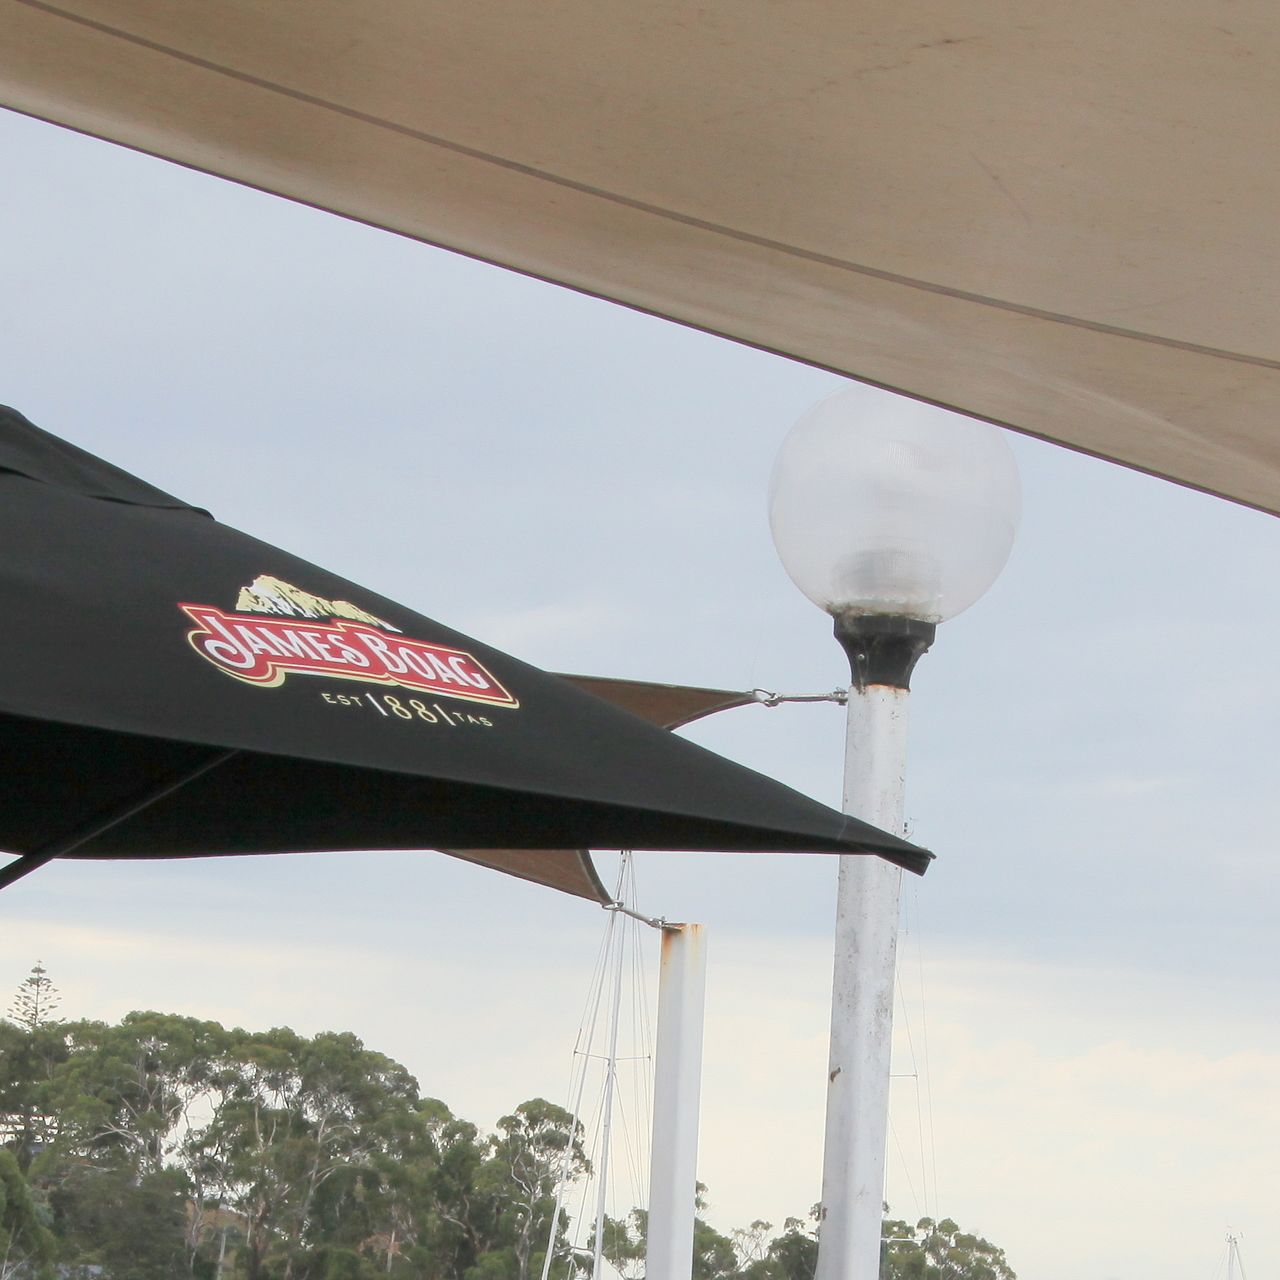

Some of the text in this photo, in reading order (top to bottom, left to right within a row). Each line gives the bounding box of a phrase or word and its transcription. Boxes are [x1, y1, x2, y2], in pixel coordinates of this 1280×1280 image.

[204, 615, 490, 690] JAMES BOAG
[321, 692, 494, 727] EST 1881 TAS
